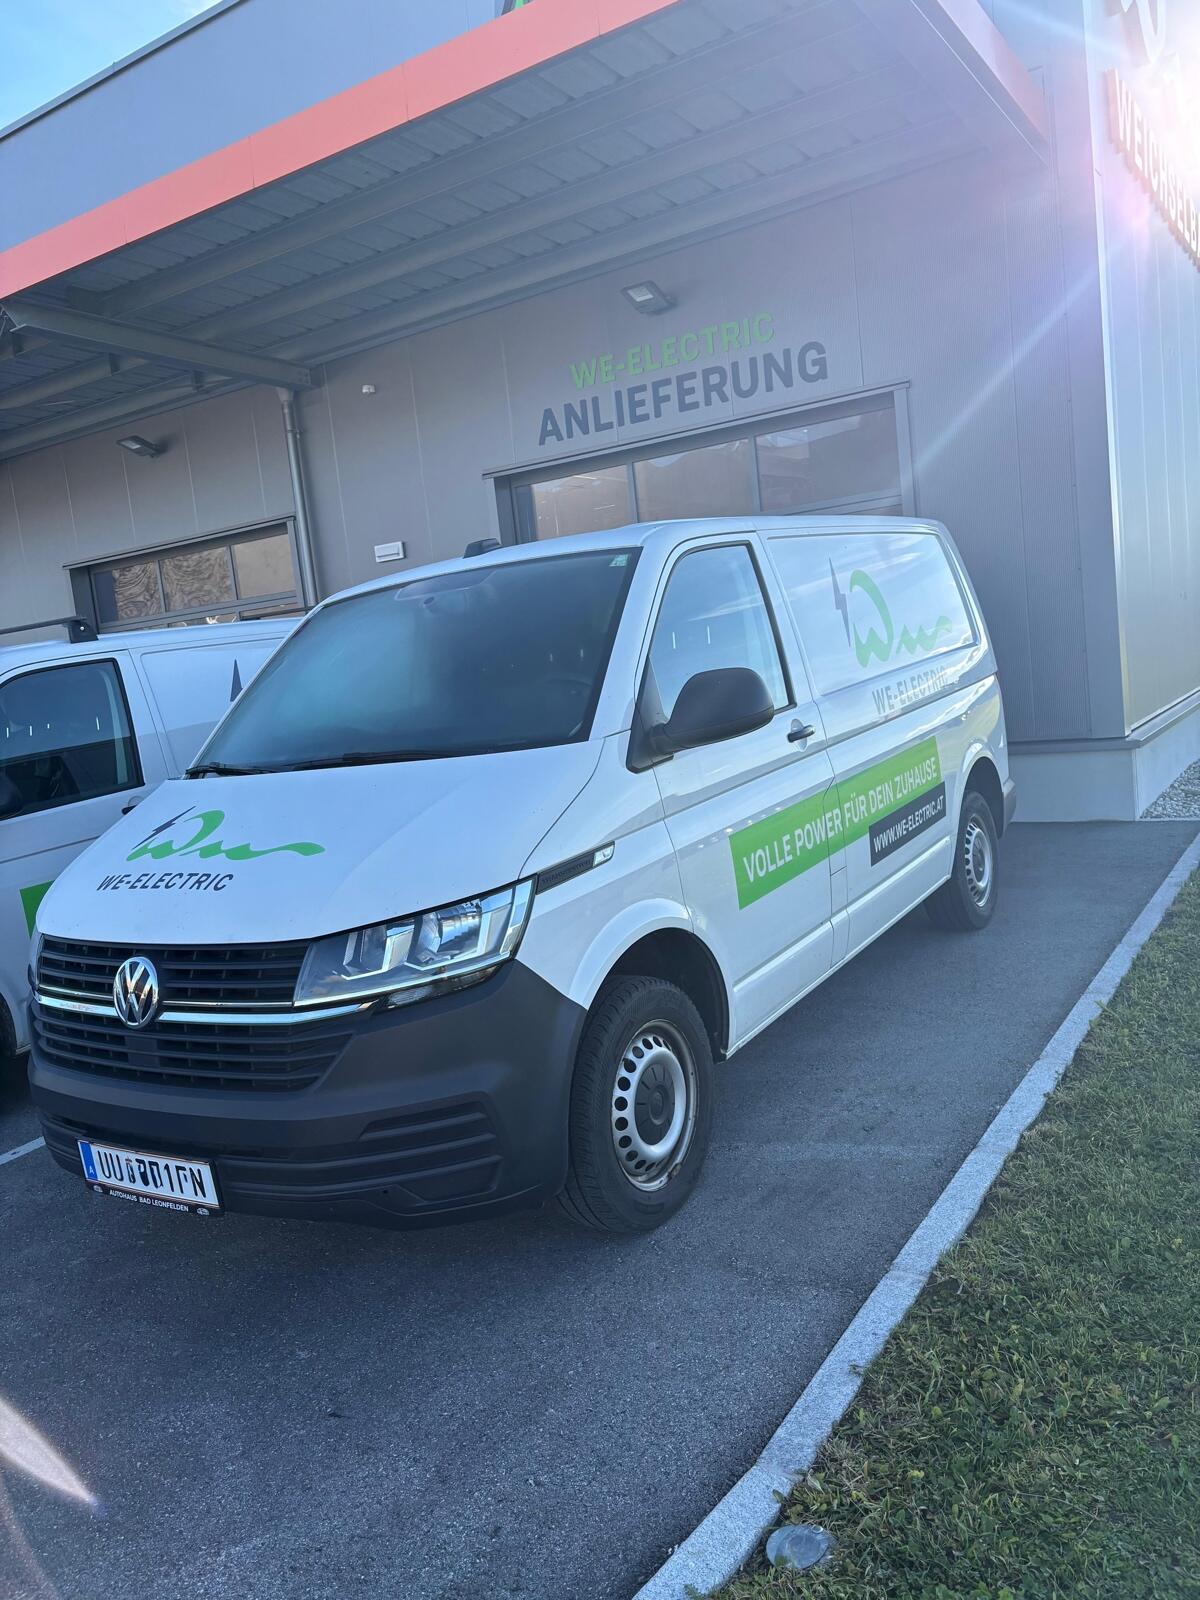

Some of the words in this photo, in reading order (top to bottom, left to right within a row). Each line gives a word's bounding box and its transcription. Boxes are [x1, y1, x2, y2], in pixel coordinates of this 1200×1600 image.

[569, 312, 775, 390] WE-ELECTRIC
[538, 341, 828, 446] ANLIEFERUNG
[743, 834, 794, 883] VOLLE
[795, 807, 842, 857] POWER
[843, 793, 869, 828] FÜR
[869, 782, 894, 815] DEIN
[895, 757, 938, 798] ZUHAUSE
[873, 795, 945, 853] WWW.WE-ELECTRIC.AT
[96, 872, 234, 892] WE-ELECTRIC
[109, 1189, 137, 1203] AUTOHAUS
[138, 1196, 151, 1206] BAD
[151, 1198, 190, 1213] LEONFELDEN
